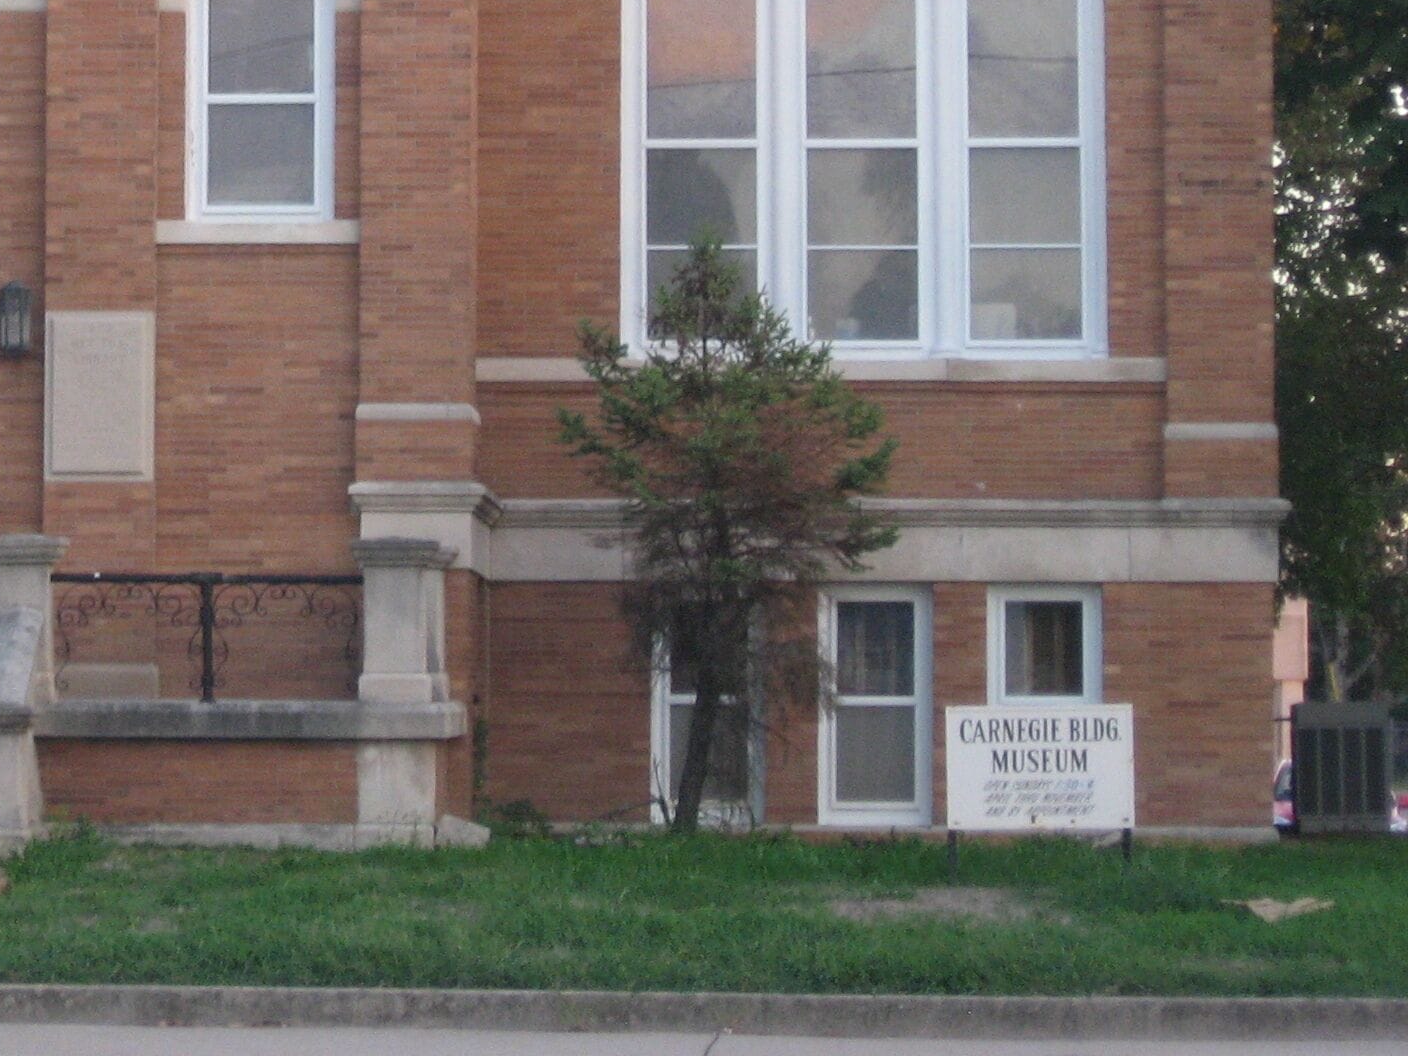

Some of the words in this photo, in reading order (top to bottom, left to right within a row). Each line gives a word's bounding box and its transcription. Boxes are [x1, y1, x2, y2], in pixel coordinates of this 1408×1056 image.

[959, 718, 1062, 744] CARNEGIE
[1069, 718, 1122, 743] BLDG.
[992, 749, 1088, 774] MUSEUM
